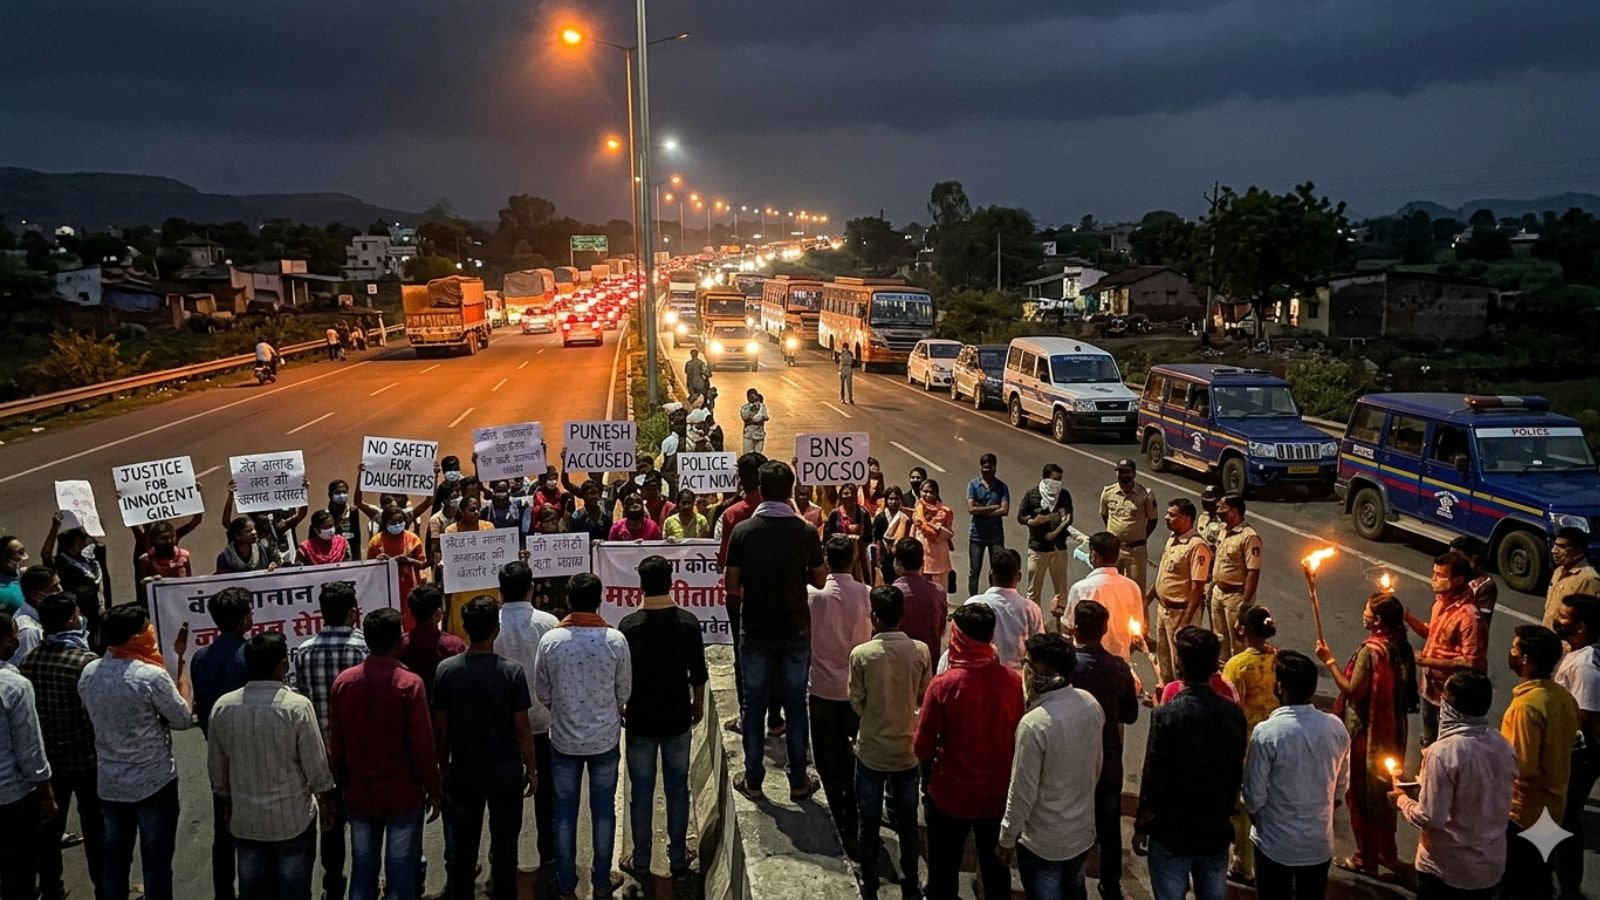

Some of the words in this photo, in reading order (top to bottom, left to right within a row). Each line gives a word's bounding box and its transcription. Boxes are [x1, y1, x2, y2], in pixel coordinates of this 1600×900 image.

[368, 440, 388, 455] NO
[392, 442, 438, 459] SAFETY
[589, 442, 612, 451] THE
[810, 436, 853, 457] BNS
[567, 452, 633, 468] ACCUSED
[681, 456, 728, 471] POLICE
[120, 460, 183, 482] JUSTICE
[364, 470, 434, 490] DAUGHTERS
[803, 461, 865, 482] POCSO
[680, 475, 706, 488] ACT
[122, 486, 194, 510] INNOCENT
[146, 505, 182, 520] GIRL
